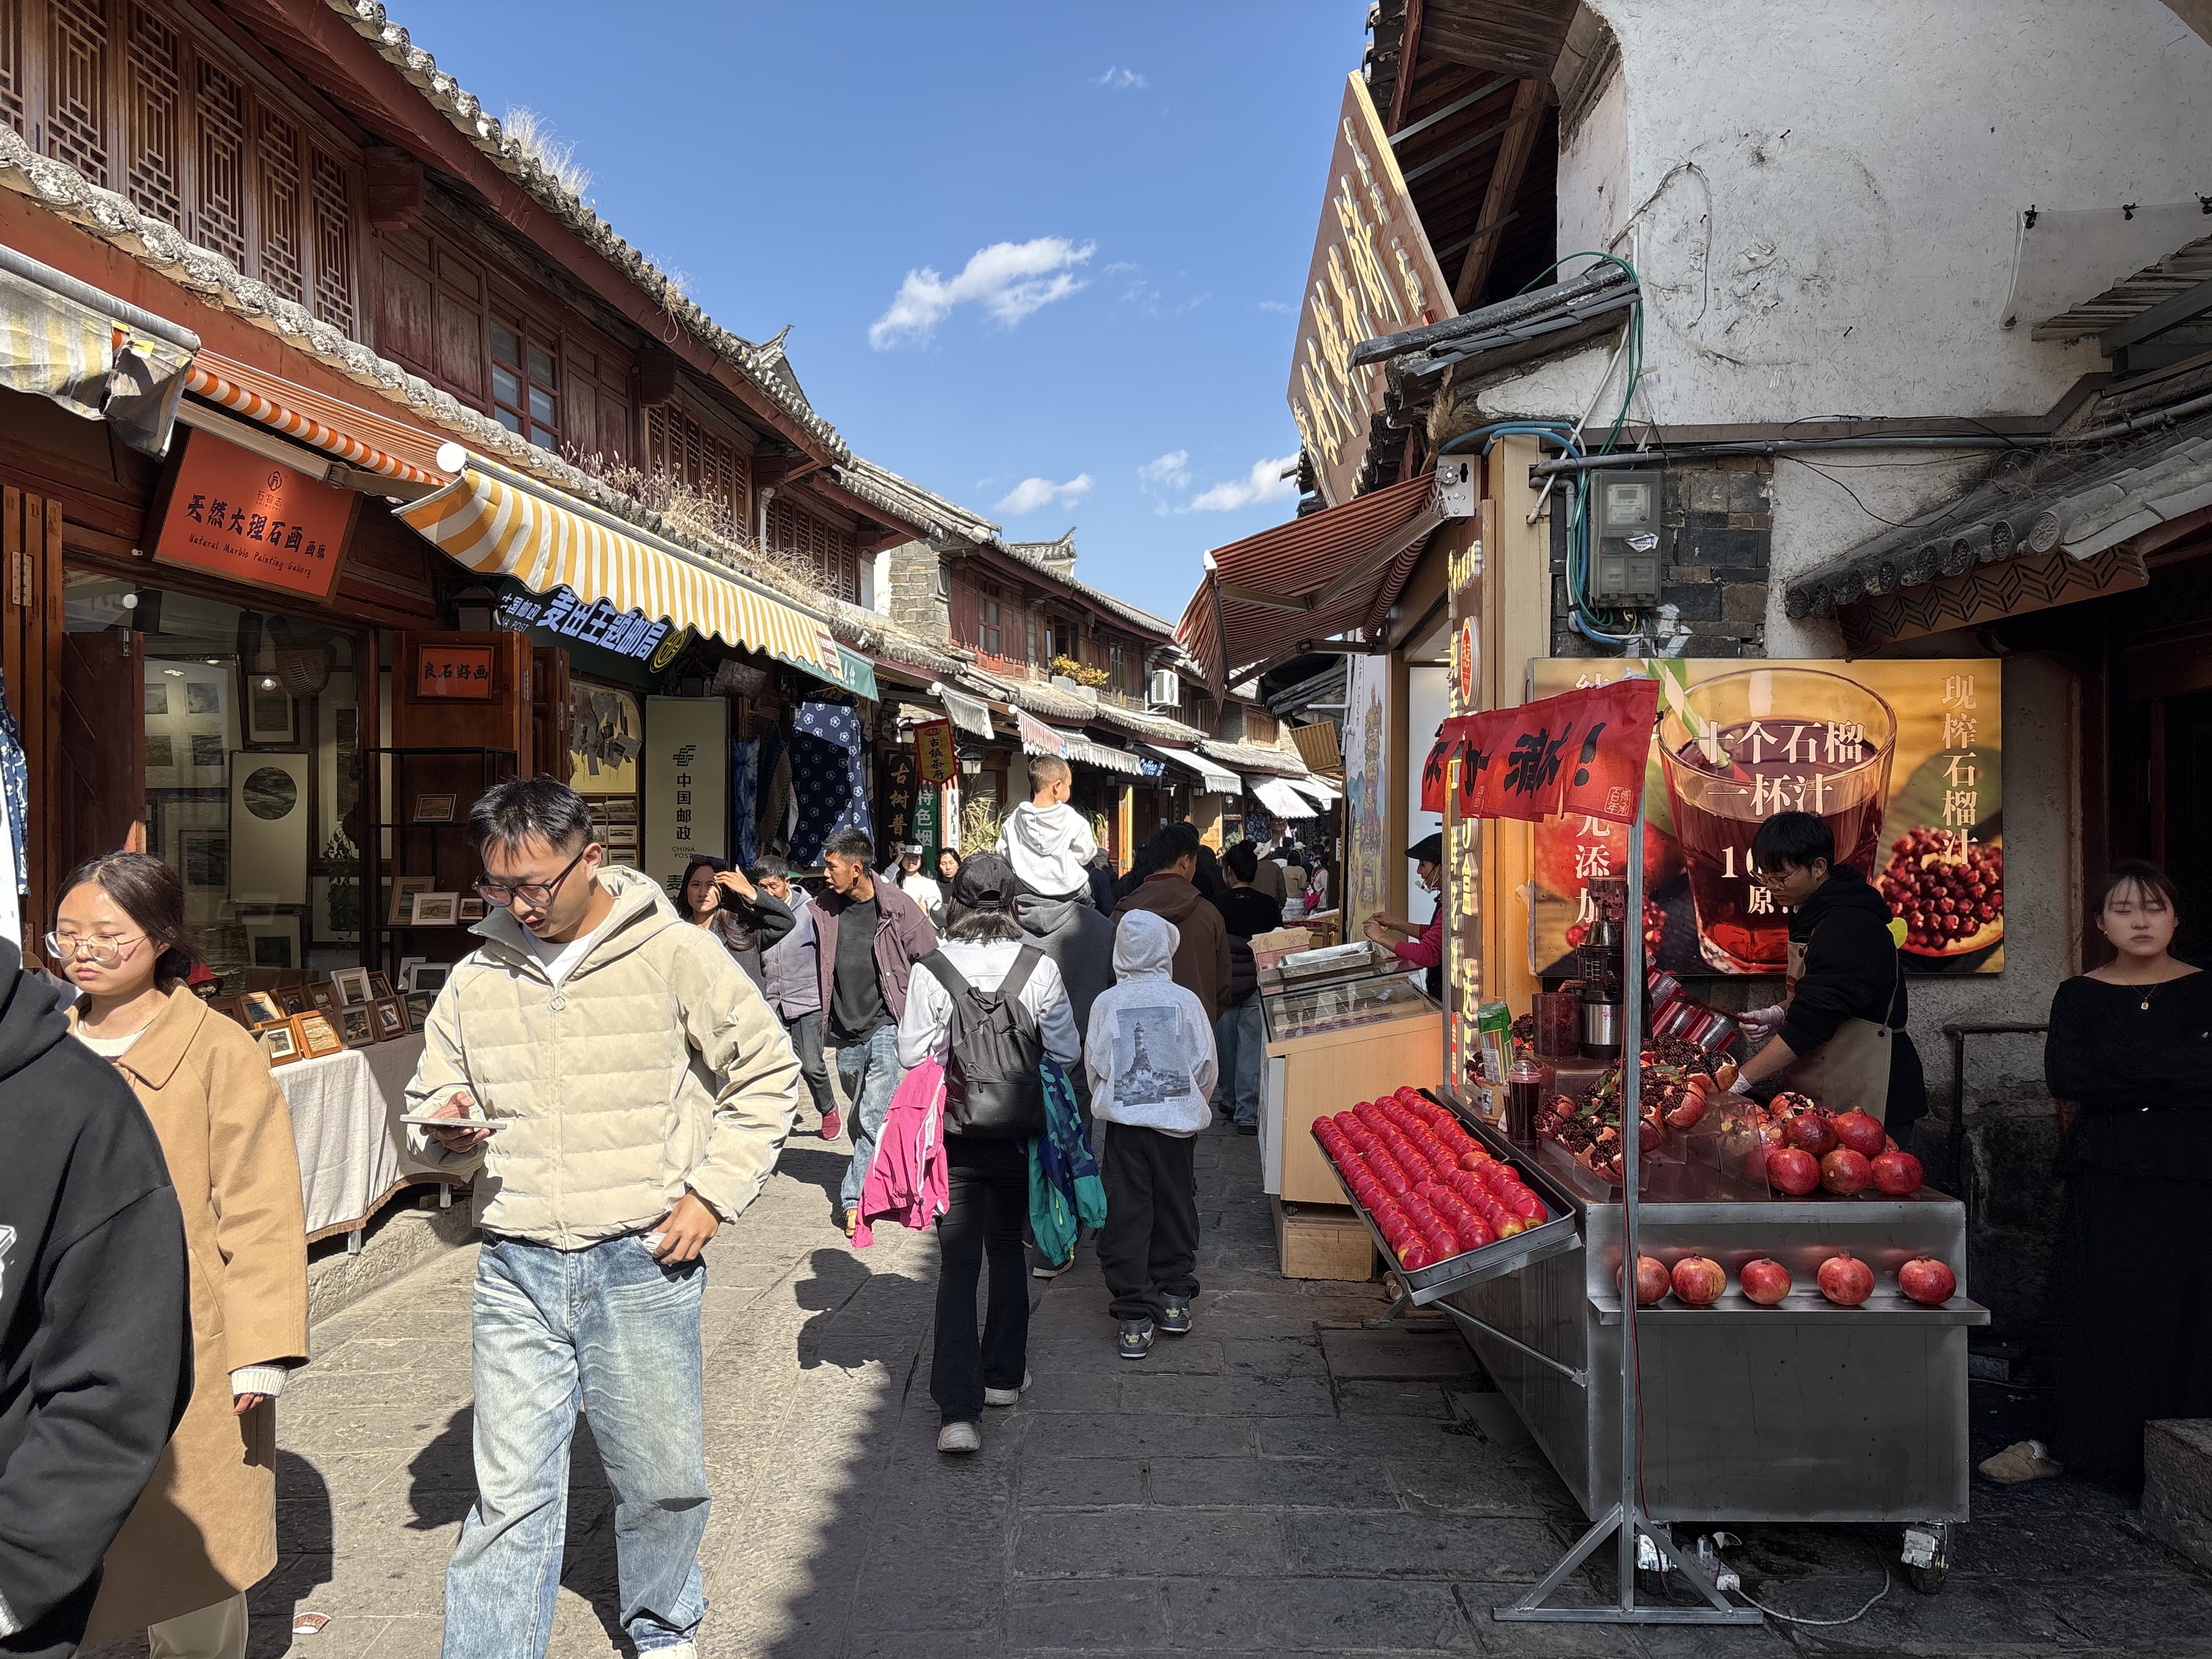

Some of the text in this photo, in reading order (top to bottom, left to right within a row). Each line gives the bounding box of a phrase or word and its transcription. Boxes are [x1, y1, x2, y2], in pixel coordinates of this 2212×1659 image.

[189, 533, 311, 578] Natural Marble Painting Gallery
[510, 620, 530, 633] POST
[424, 661, 489, 680] 良石好画
[1693, 720, 1865, 764] 十个石榴
[1940, 674, 1978, 865] 现榨石榴汁
[676, 773, 692, 841] 中国邮政
[1707, 773, 1833, 816] 一杯汁
